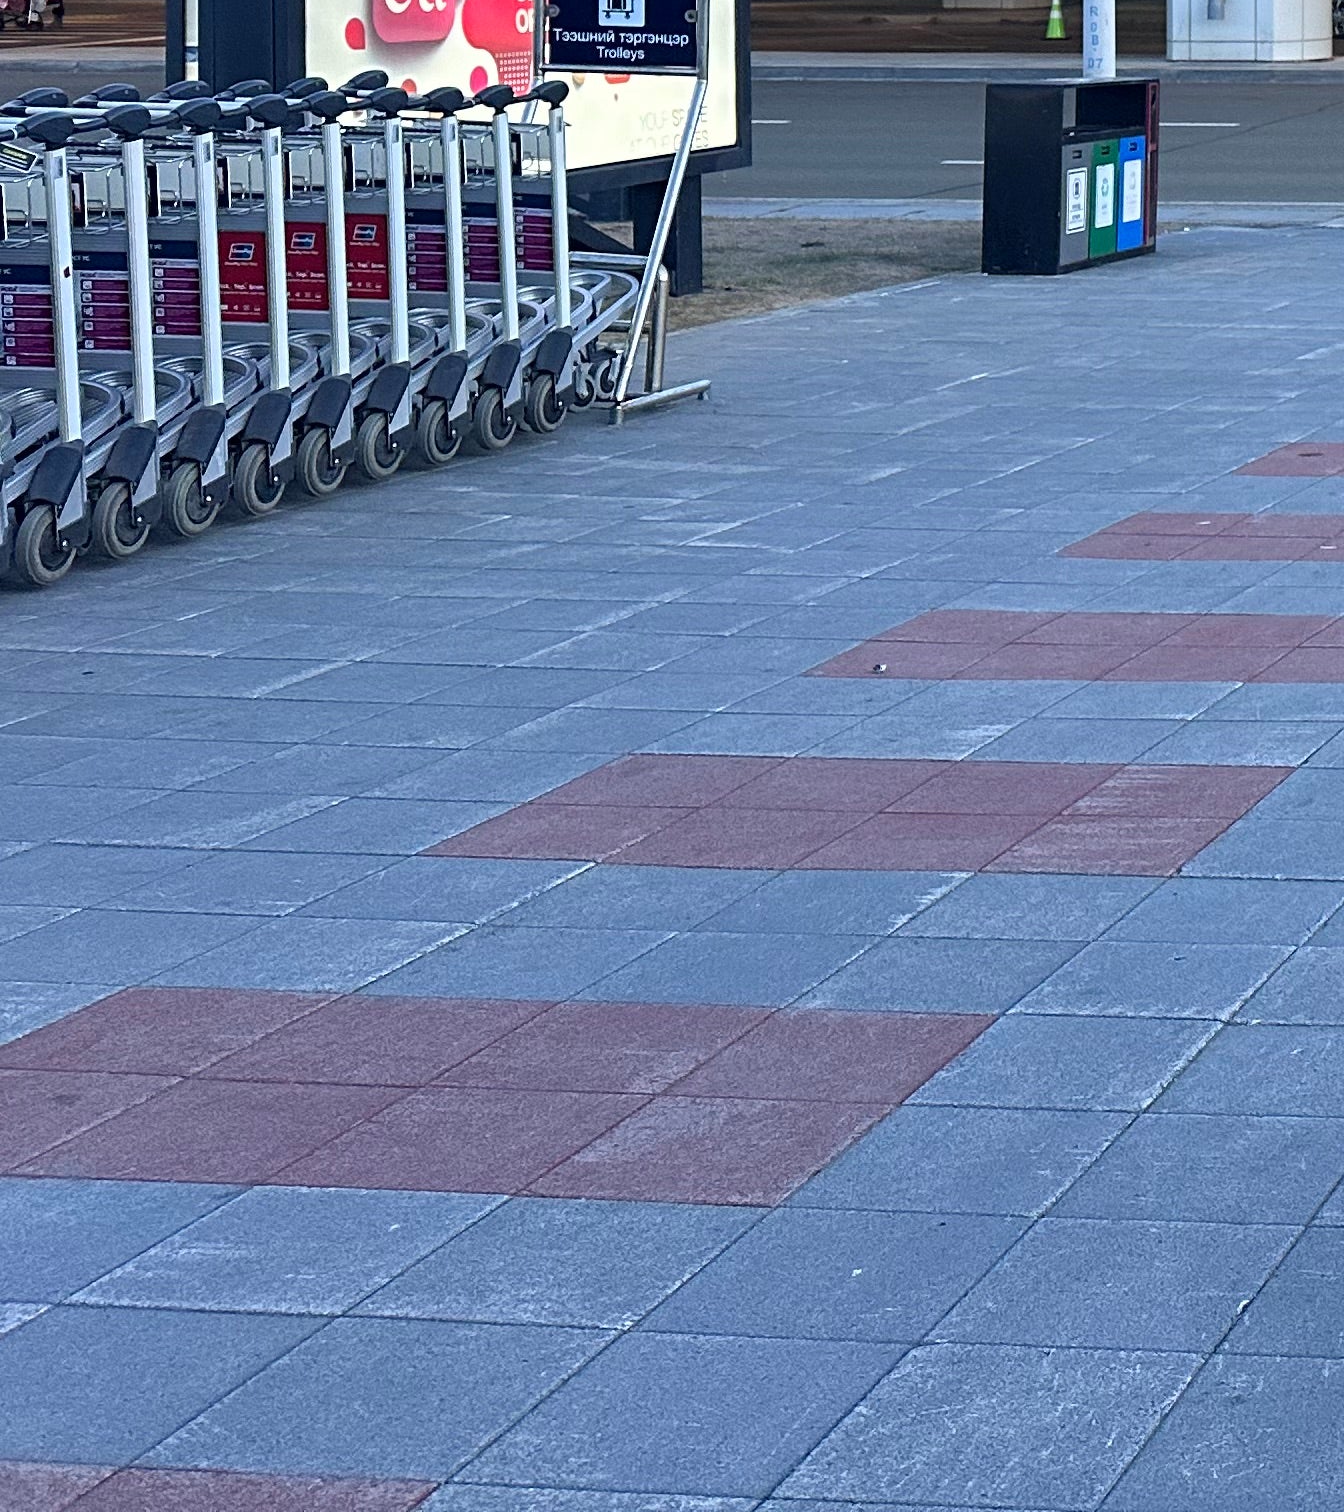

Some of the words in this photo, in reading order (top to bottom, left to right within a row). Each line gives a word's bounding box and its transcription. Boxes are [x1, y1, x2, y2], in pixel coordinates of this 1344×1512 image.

[553, 27, 615, 43] Тээшний
[619, 32, 689, 48] тэргэнцэр
[596, 45, 645, 62] Trolleys
